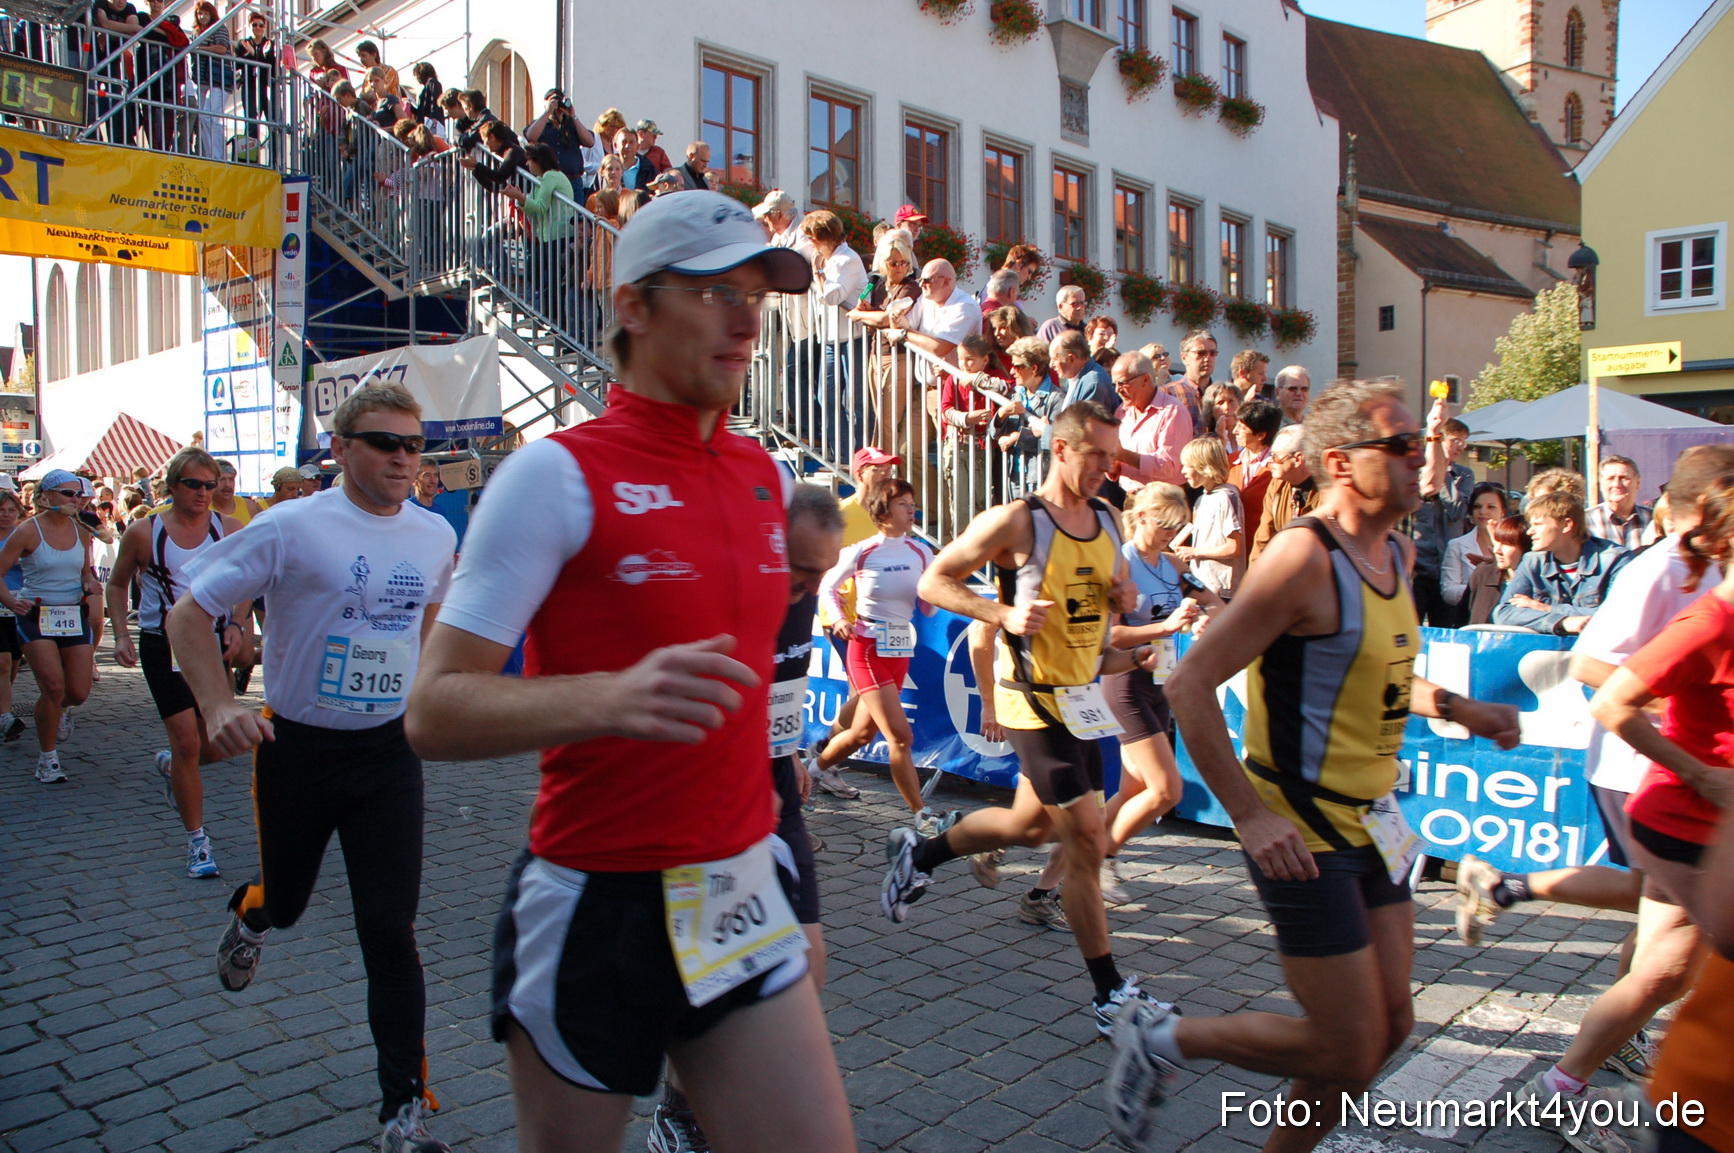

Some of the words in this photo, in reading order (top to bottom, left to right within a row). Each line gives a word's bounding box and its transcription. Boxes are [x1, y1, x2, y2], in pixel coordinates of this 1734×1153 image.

[109, 193, 188, 214] Neumarkter
[189, 203, 246, 221] Stadtlauf
[1591, 348, 1664, 363] Startnummern-
[1606, 361, 1648, 373] ausgabe
[342, 606, 359, 620] 8.
[55, 619, 75, 629] 418
[352, 644, 387, 665] Georg
[349, 671, 403, 693] 3105
[1079, 707, 1107, 724] 981
